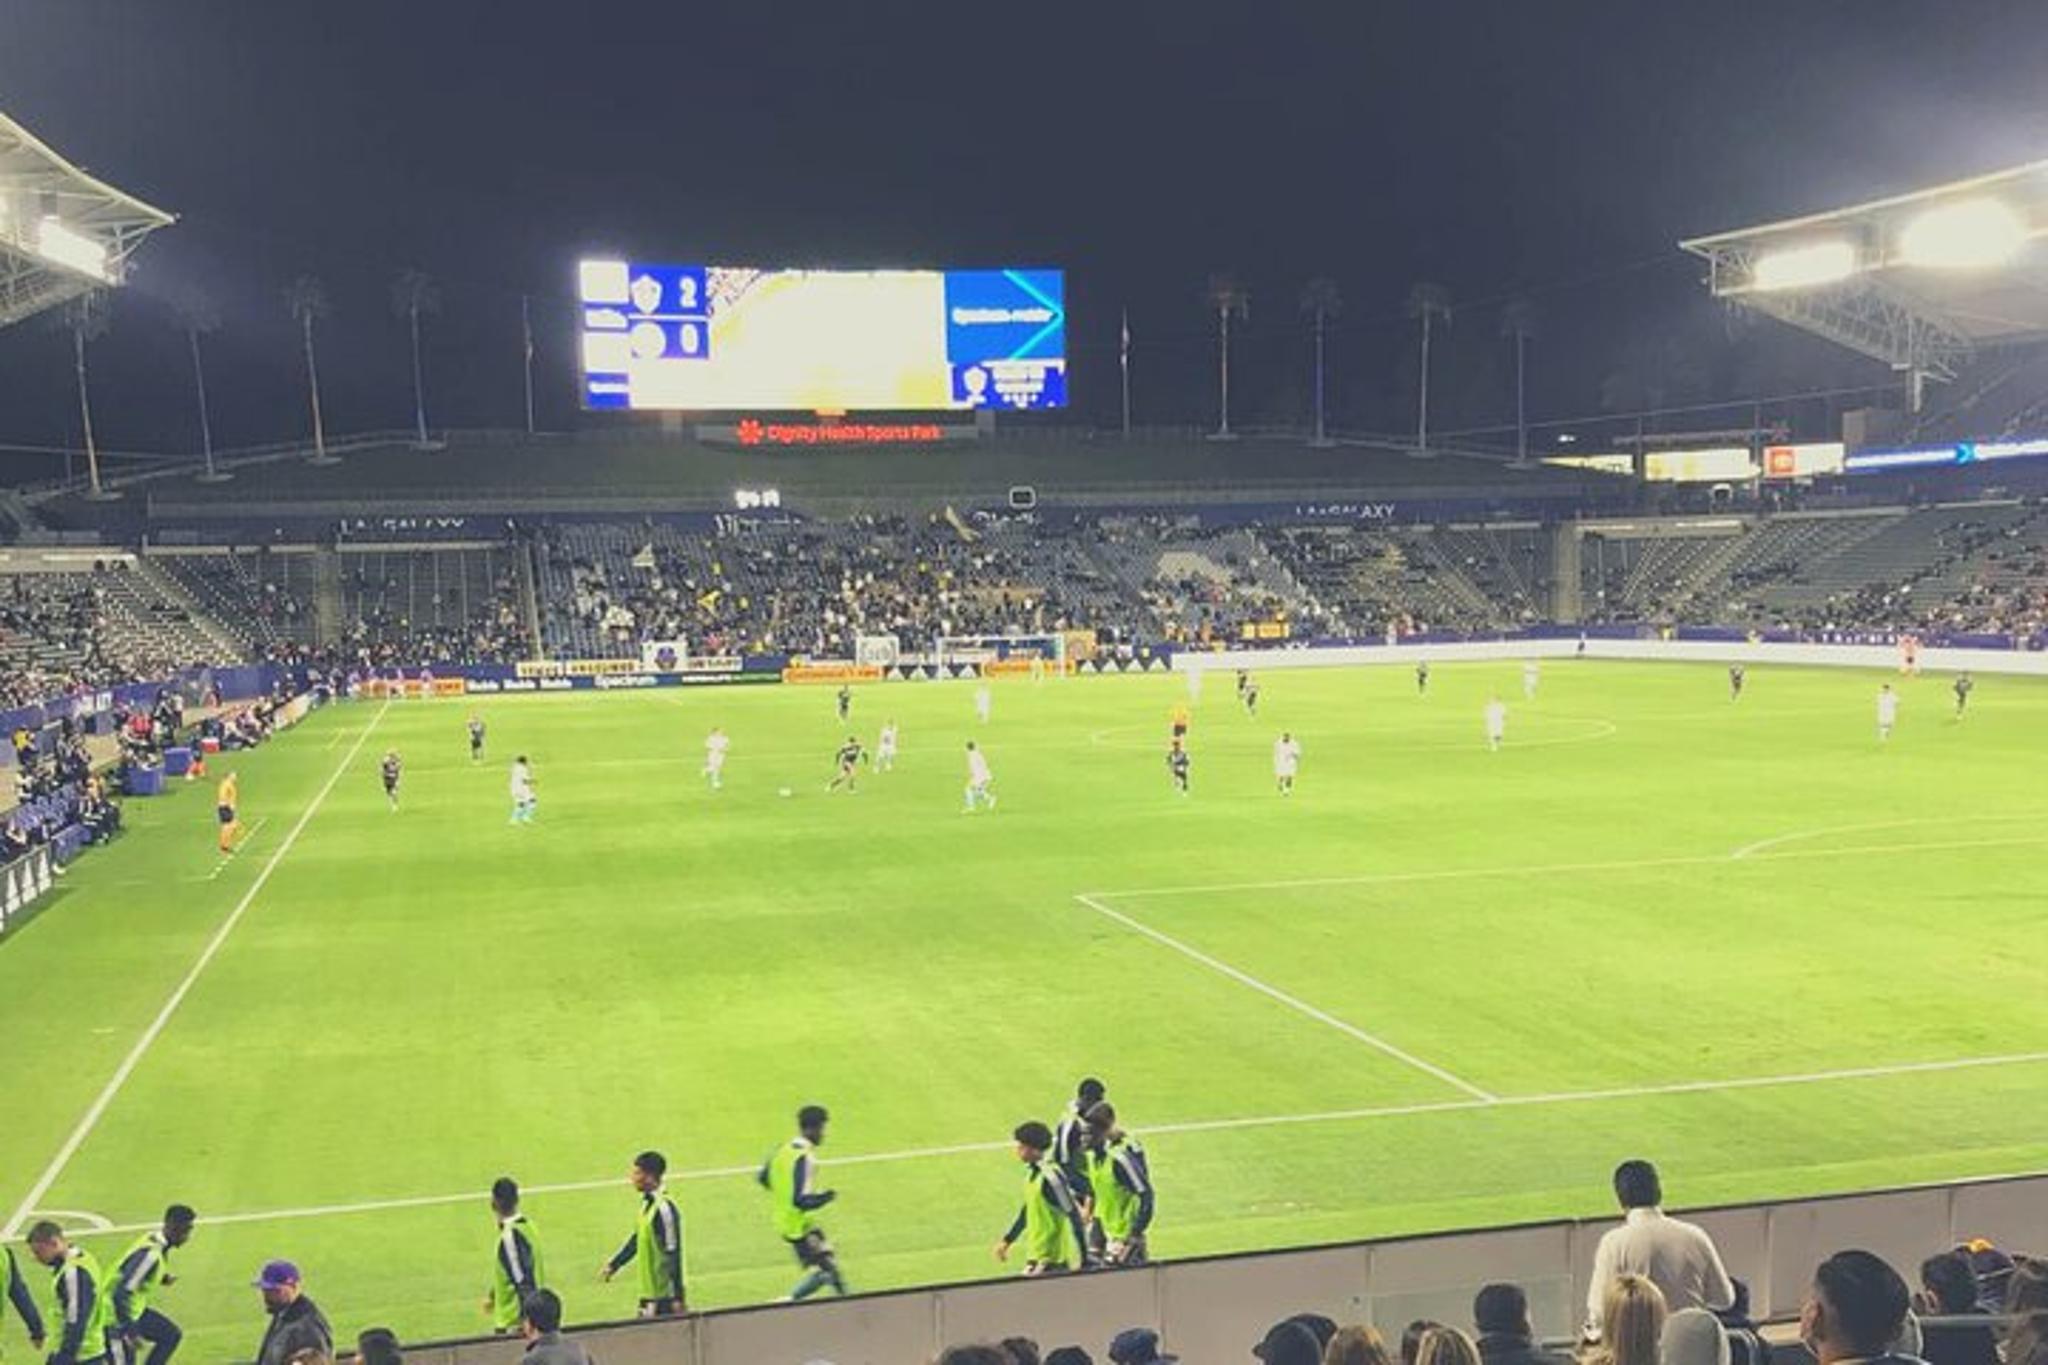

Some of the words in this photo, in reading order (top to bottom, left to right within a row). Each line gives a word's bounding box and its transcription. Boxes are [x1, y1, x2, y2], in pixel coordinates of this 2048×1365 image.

[680, 275, 697, 308] 2
[680, 322, 698, 354] 0
[767, 425, 817, 443] Dignity
[818, 425, 865, 439] Health
[866, 425, 909, 441] Sports
[911, 425, 940, 439] Park
